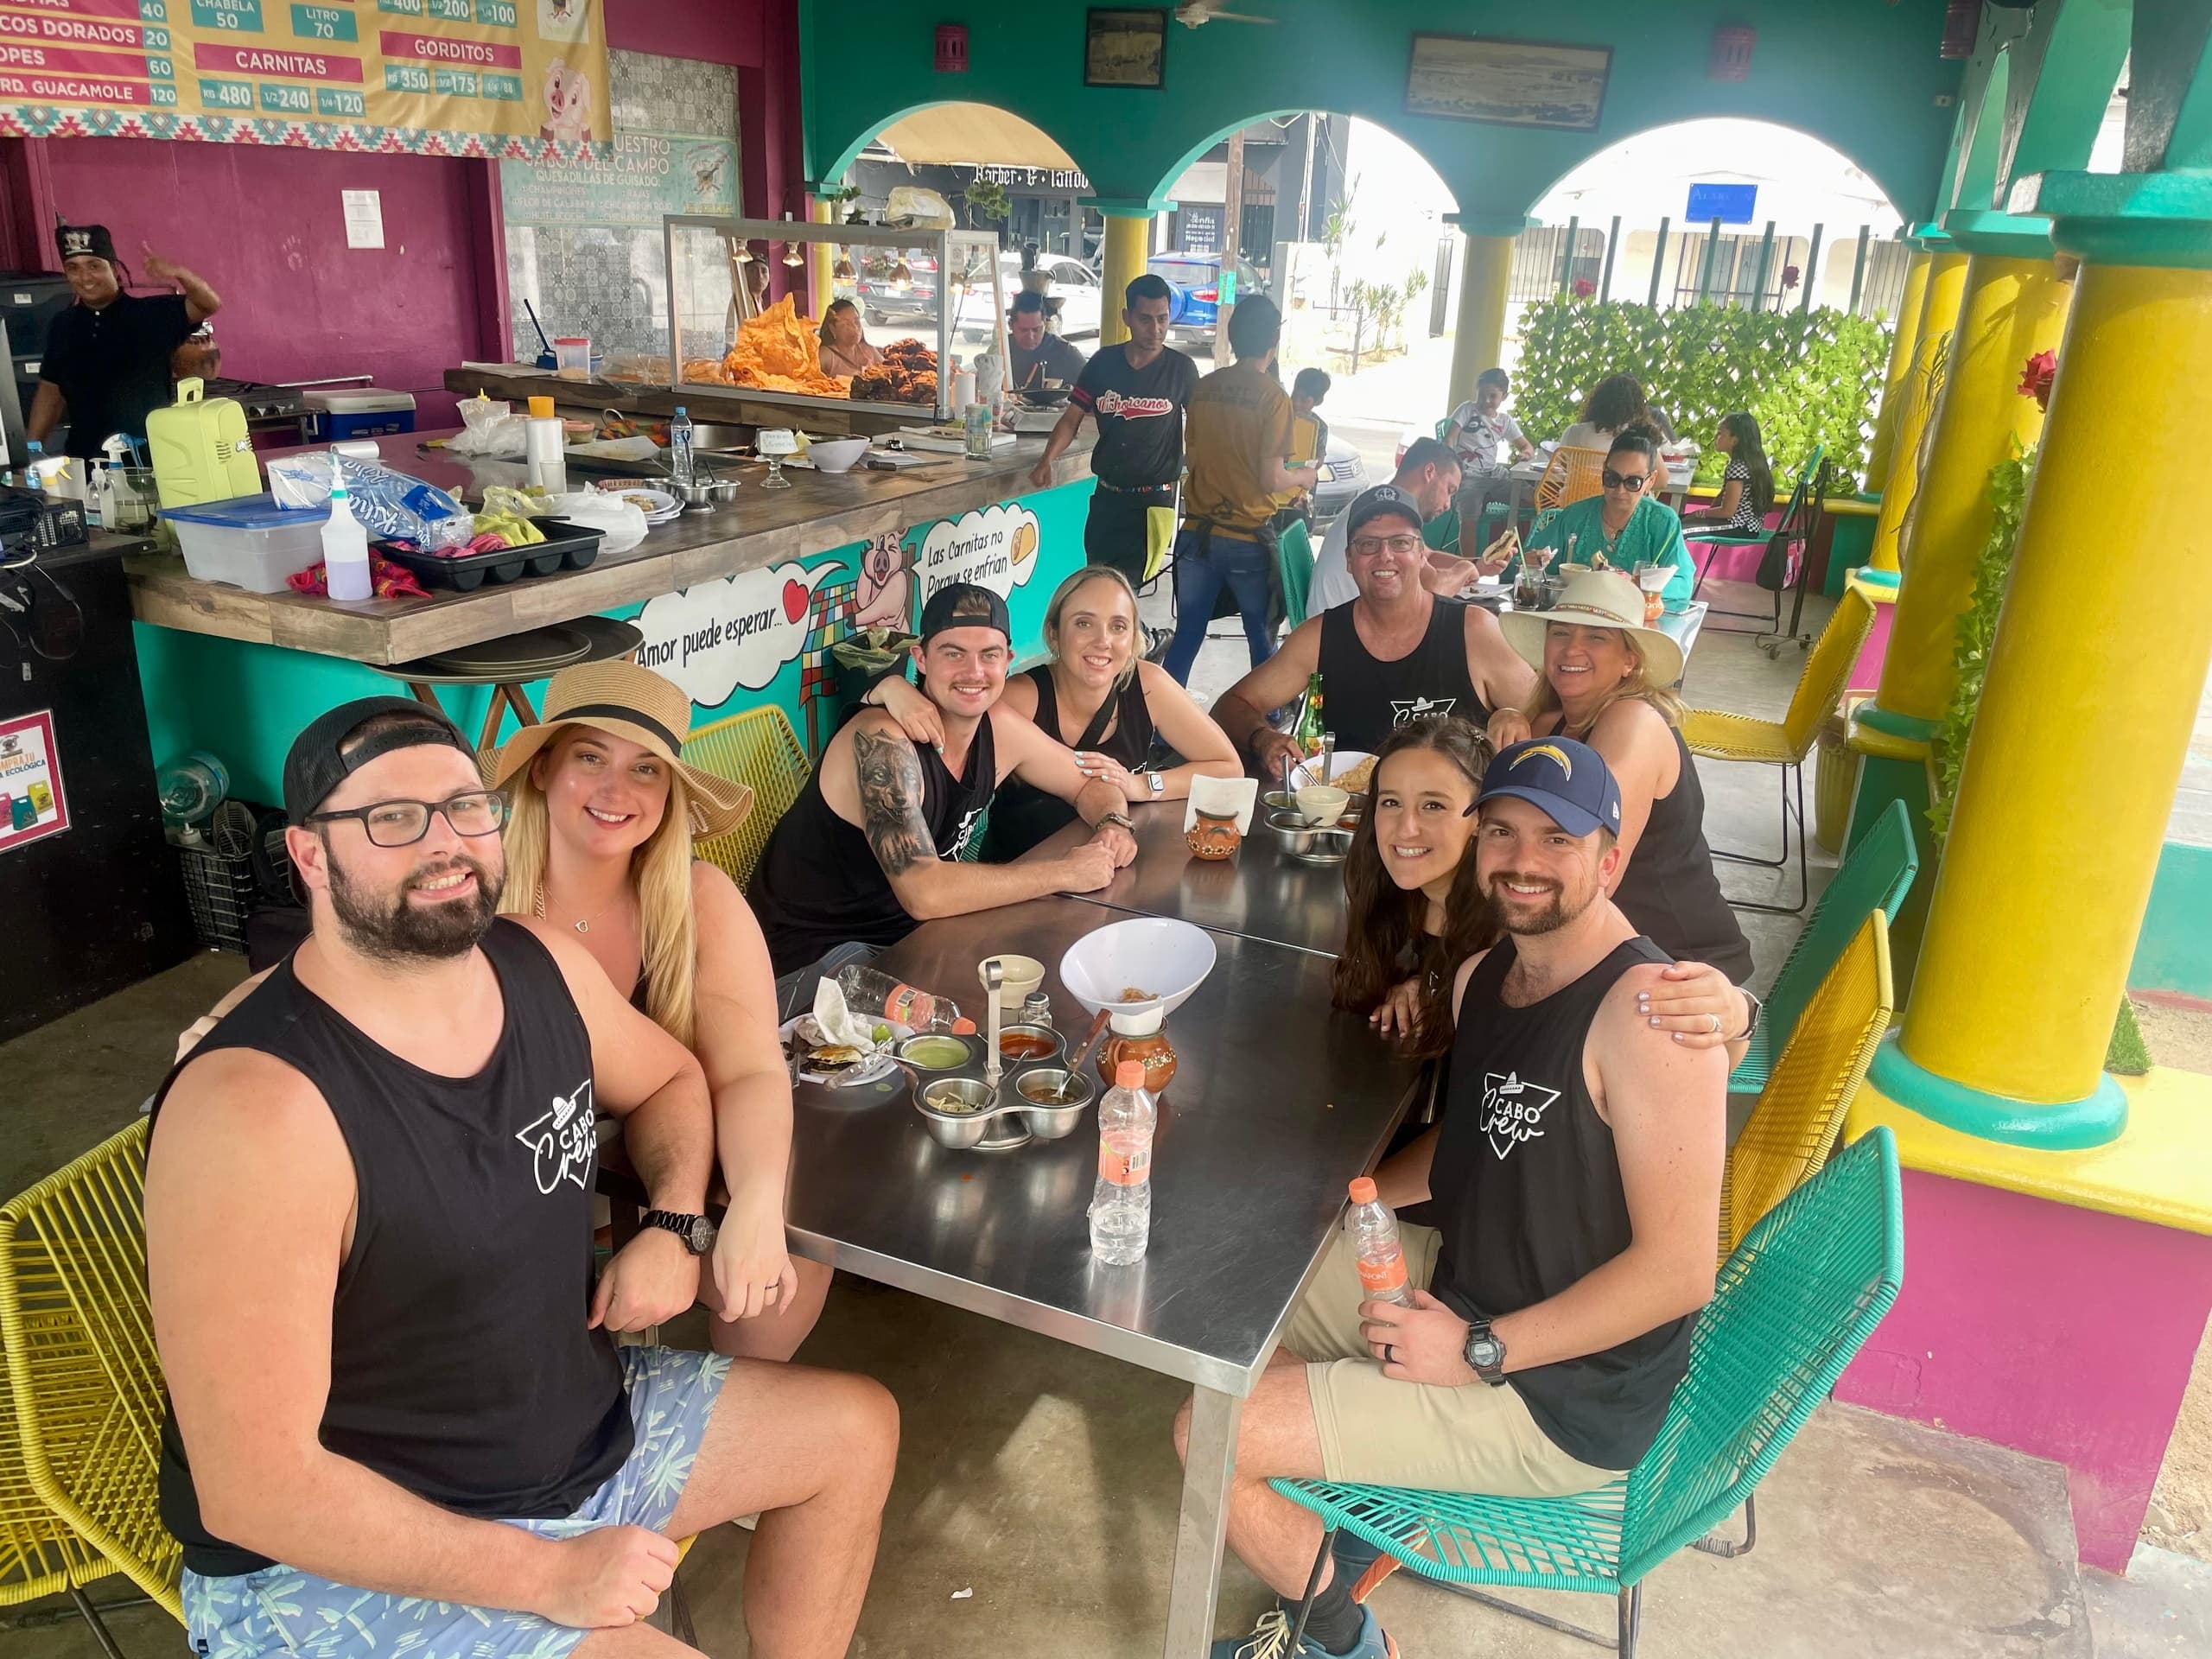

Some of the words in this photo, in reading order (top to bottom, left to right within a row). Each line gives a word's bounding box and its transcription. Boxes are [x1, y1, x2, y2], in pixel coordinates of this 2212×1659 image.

[143, 3, 164, 17] 40
[196, 0, 255, 13] CHABELA
[306, 8, 339, 22] LITRO
[444, 0, 468, 17] 200
[492, 5, 515, 23] 100
[216, 12, 238, 29] 50
[315, 22, 334, 38] 70
[42, 21, 136, 43] DORADOS
[146, 32, 167, 46] 20
[415, 39, 494, 62] GORDITOS
[149, 61, 170, 75] 60
[235, 51, 327, 75] CARNITAS
[401, 69, 429, 89] 350
[451, 75, 475, 93] 175
[32, 80, 133, 100] GUACAMOLE
[151, 89, 175, 102] 120
[219, 86, 251, 106] 480
[278, 89, 309, 109] 240
[334, 94, 363, 113] 120
[614, 134, 670, 155] UESTRO
[536, 170, 601, 185] QUESADILLAS
[603, 174, 614, 185] DE
[928, 546, 944, 568] Las
[948, 533, 988, 560] Carnitas
[990, 531, 1003, 546] no
[963, 568, 973, 583] se
[638, 639, 677, 668] Amor
[683, 617, 721, 669] puede
[1480, 1088, 1545, 1141] Crew
[1495, 1098, 1541, 1123] CABO
[560, 1109, 594, 1149] CABO
[534, 1130, 596, 1194] Crew
